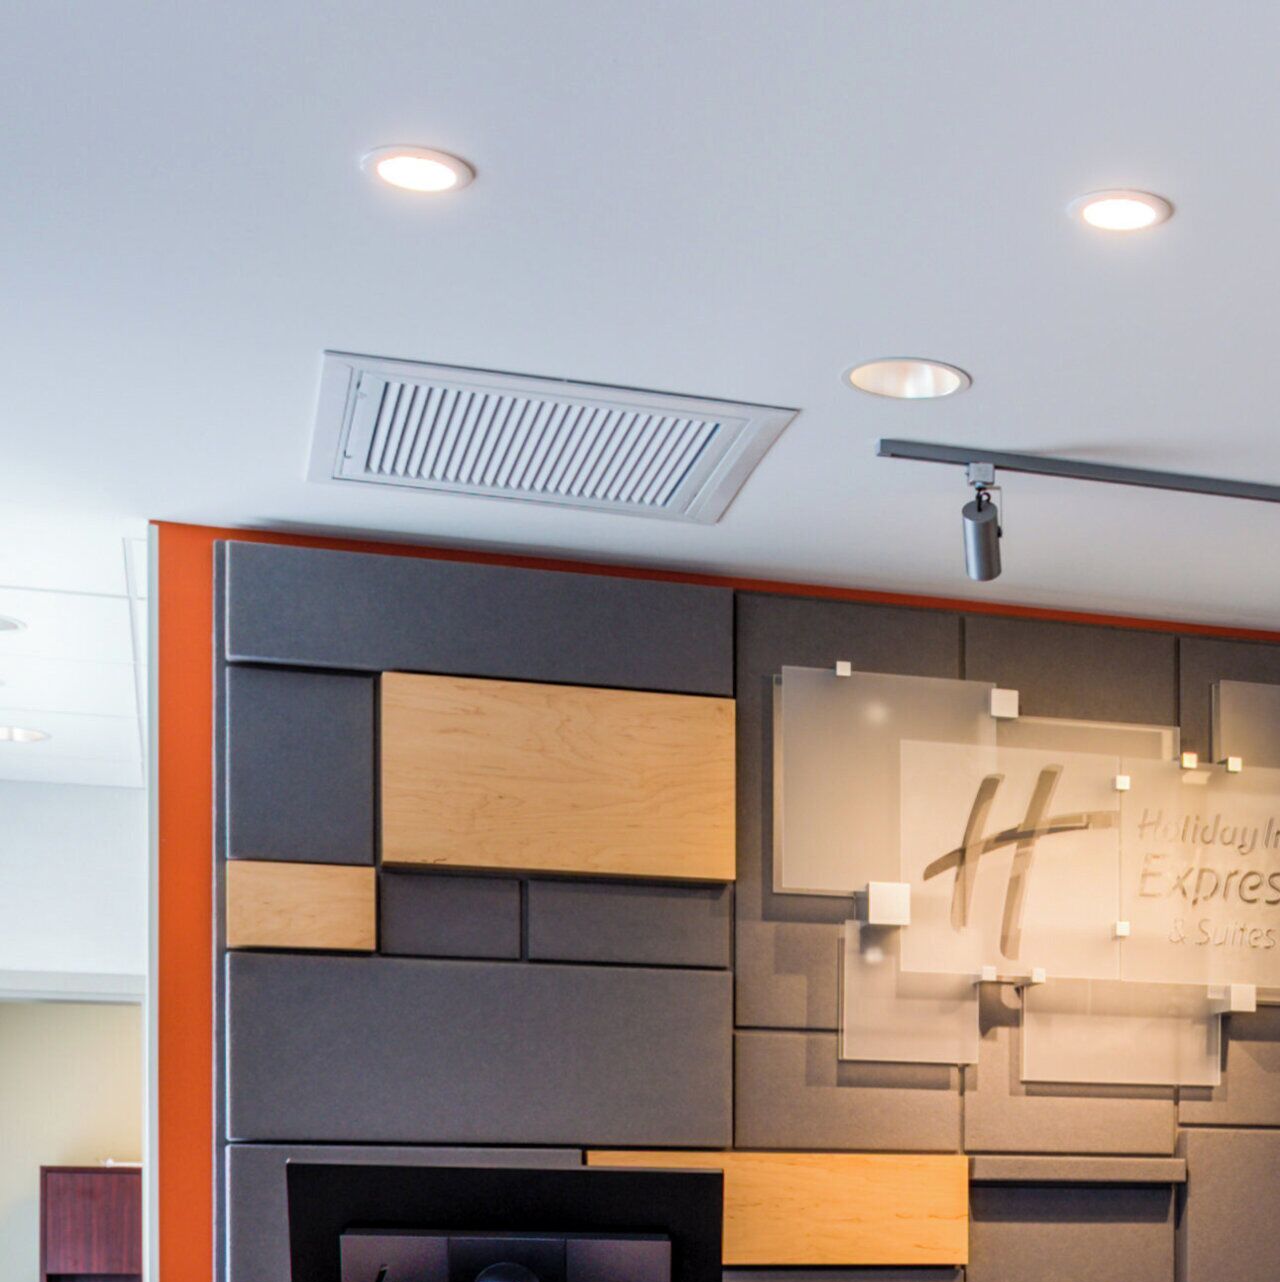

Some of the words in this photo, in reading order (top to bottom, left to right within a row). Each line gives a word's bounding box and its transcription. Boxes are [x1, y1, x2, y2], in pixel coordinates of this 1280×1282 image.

[1138, 808, 1258, 855] Holiday
[1168, 918, 1186, 944] &
[1194, 918, 1277, 949] Suites
